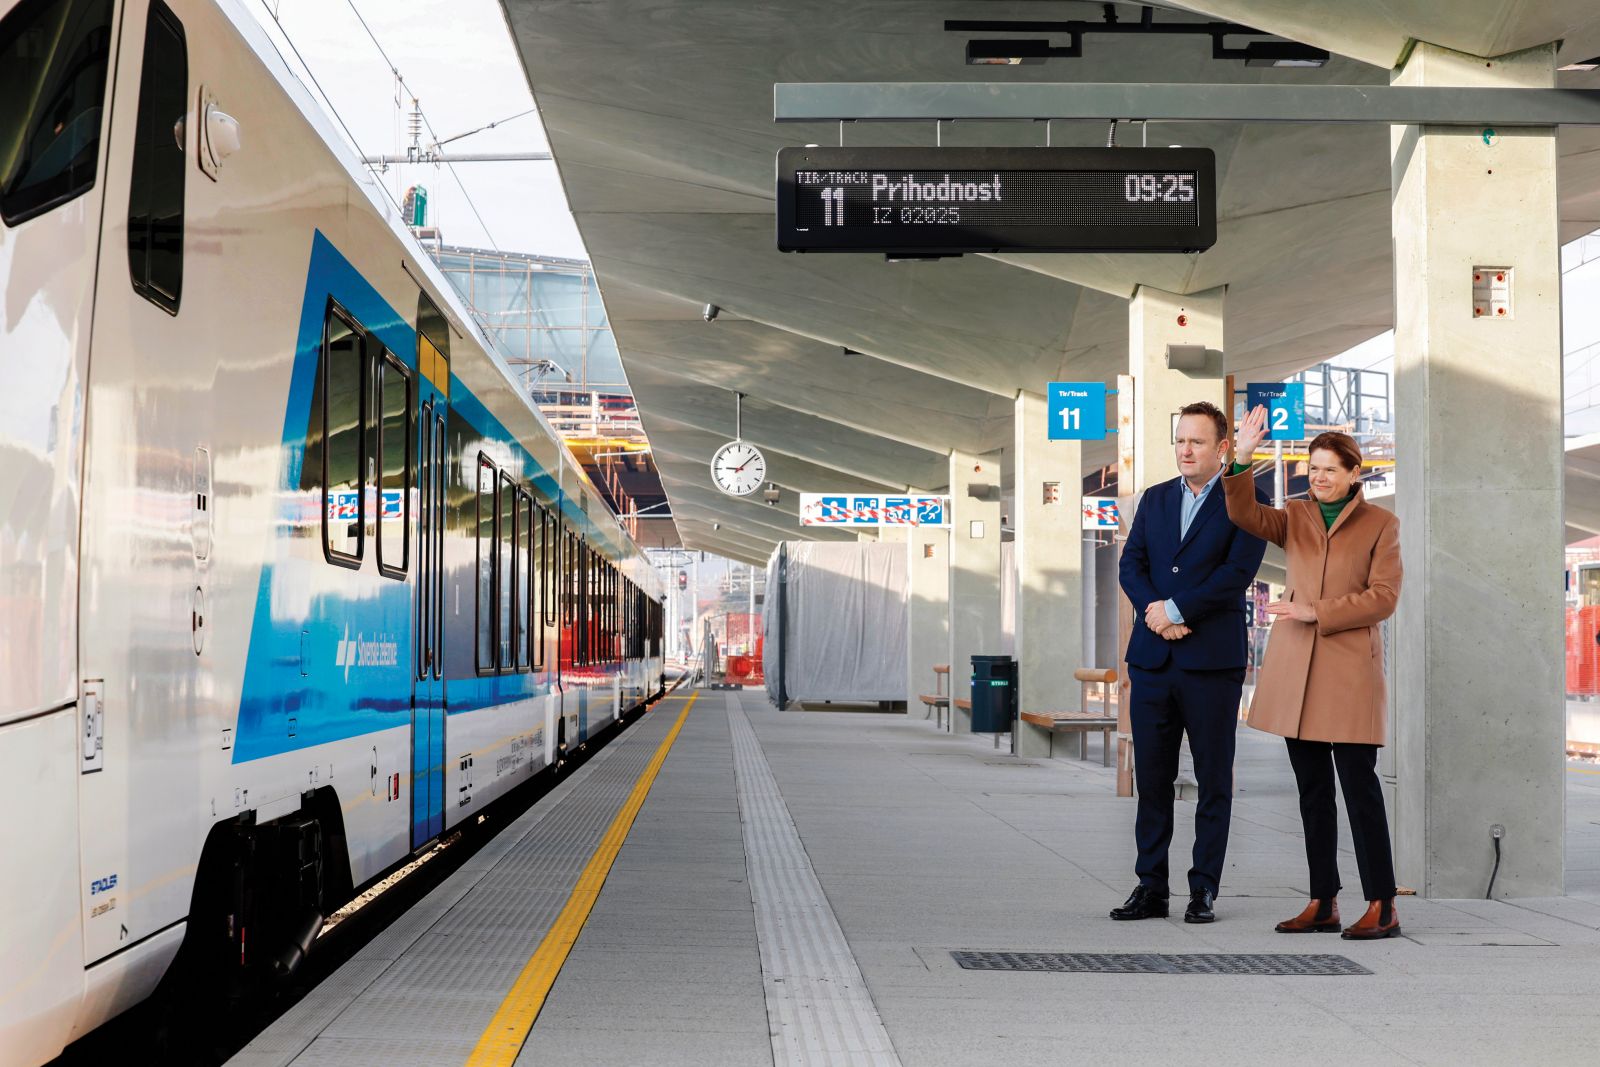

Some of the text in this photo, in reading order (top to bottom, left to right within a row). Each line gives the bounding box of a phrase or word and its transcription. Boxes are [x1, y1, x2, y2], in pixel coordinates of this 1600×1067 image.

[796, 171, 868, 183] TIR/TRACK
[872, 174, 1002, 201] Prihodnost
[1124, 174, 1195, 201] 09:25
[820, 187, 844, 226] 11
[872, 207, 960, 224] IZ 02025
[1058, 407, 1080, 430] 11
